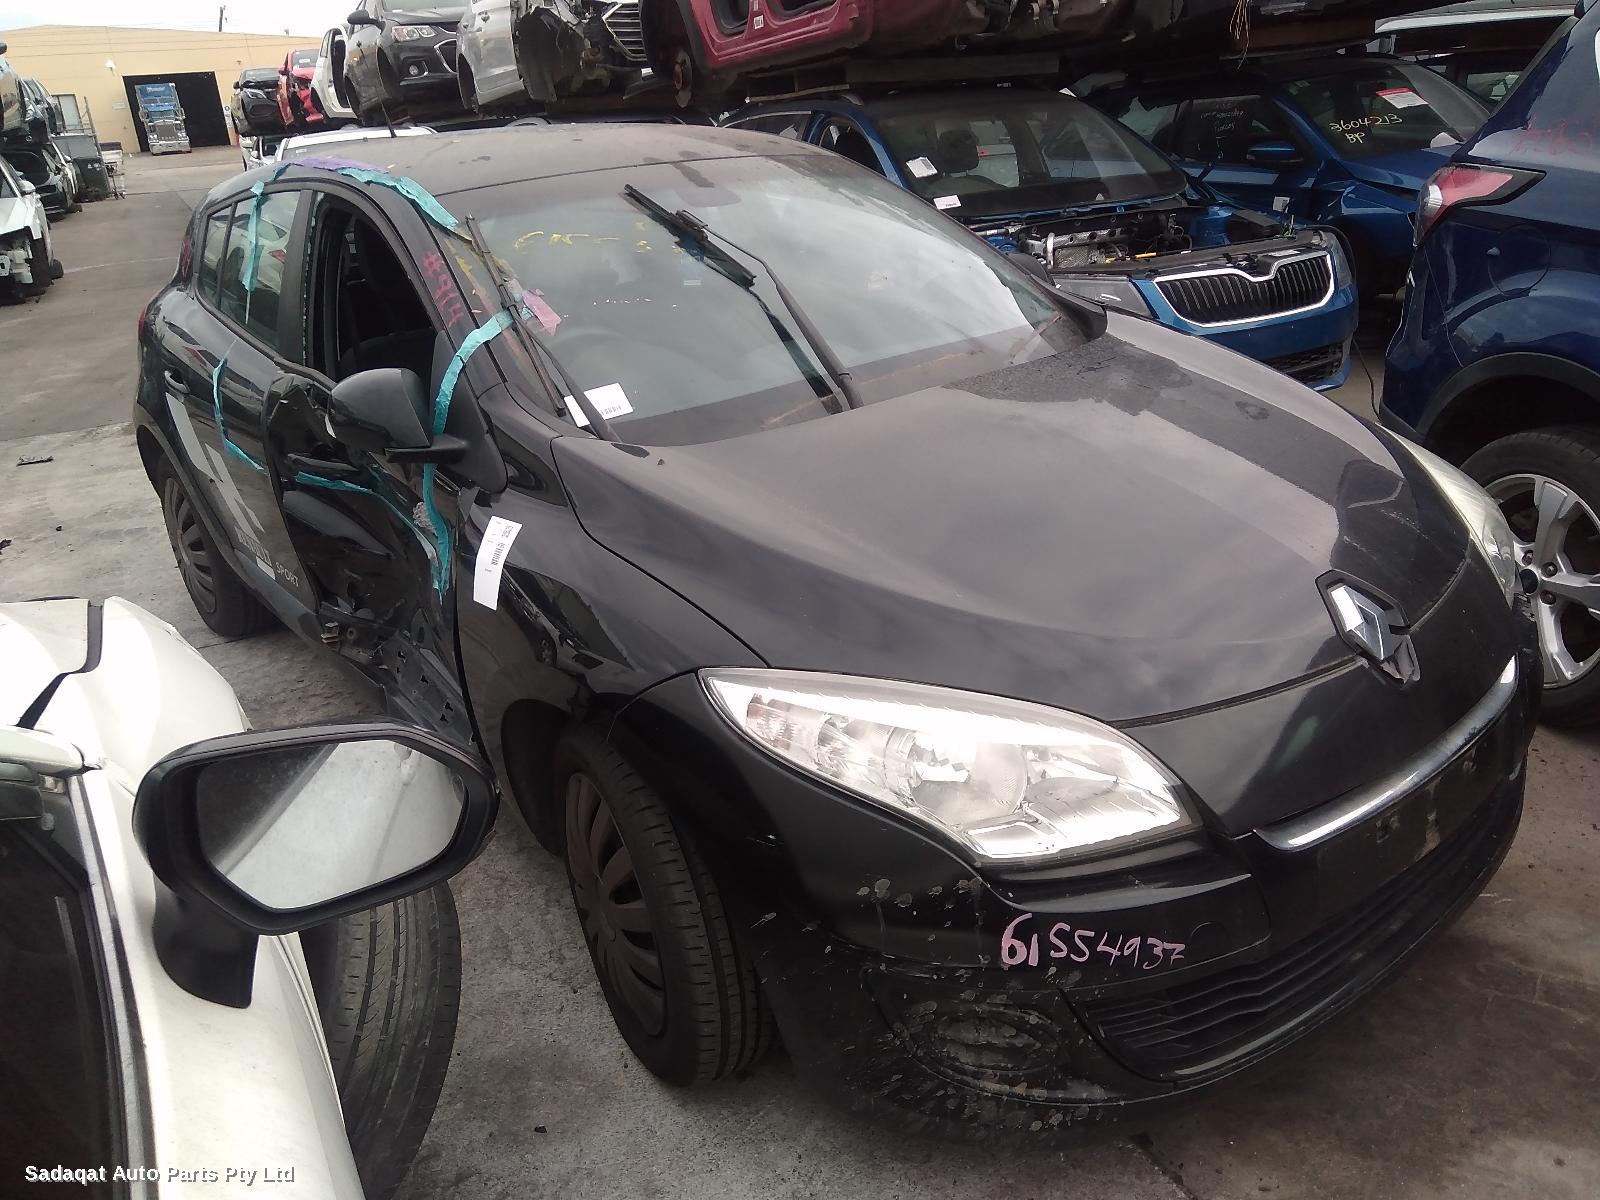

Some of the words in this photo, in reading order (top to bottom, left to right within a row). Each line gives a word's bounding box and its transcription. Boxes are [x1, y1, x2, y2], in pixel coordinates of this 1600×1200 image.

[1329, 113, 1403, 132] 3604213
[1345, 131, 1366, 144] BP
[275, 561, 299, 588] SPORT
